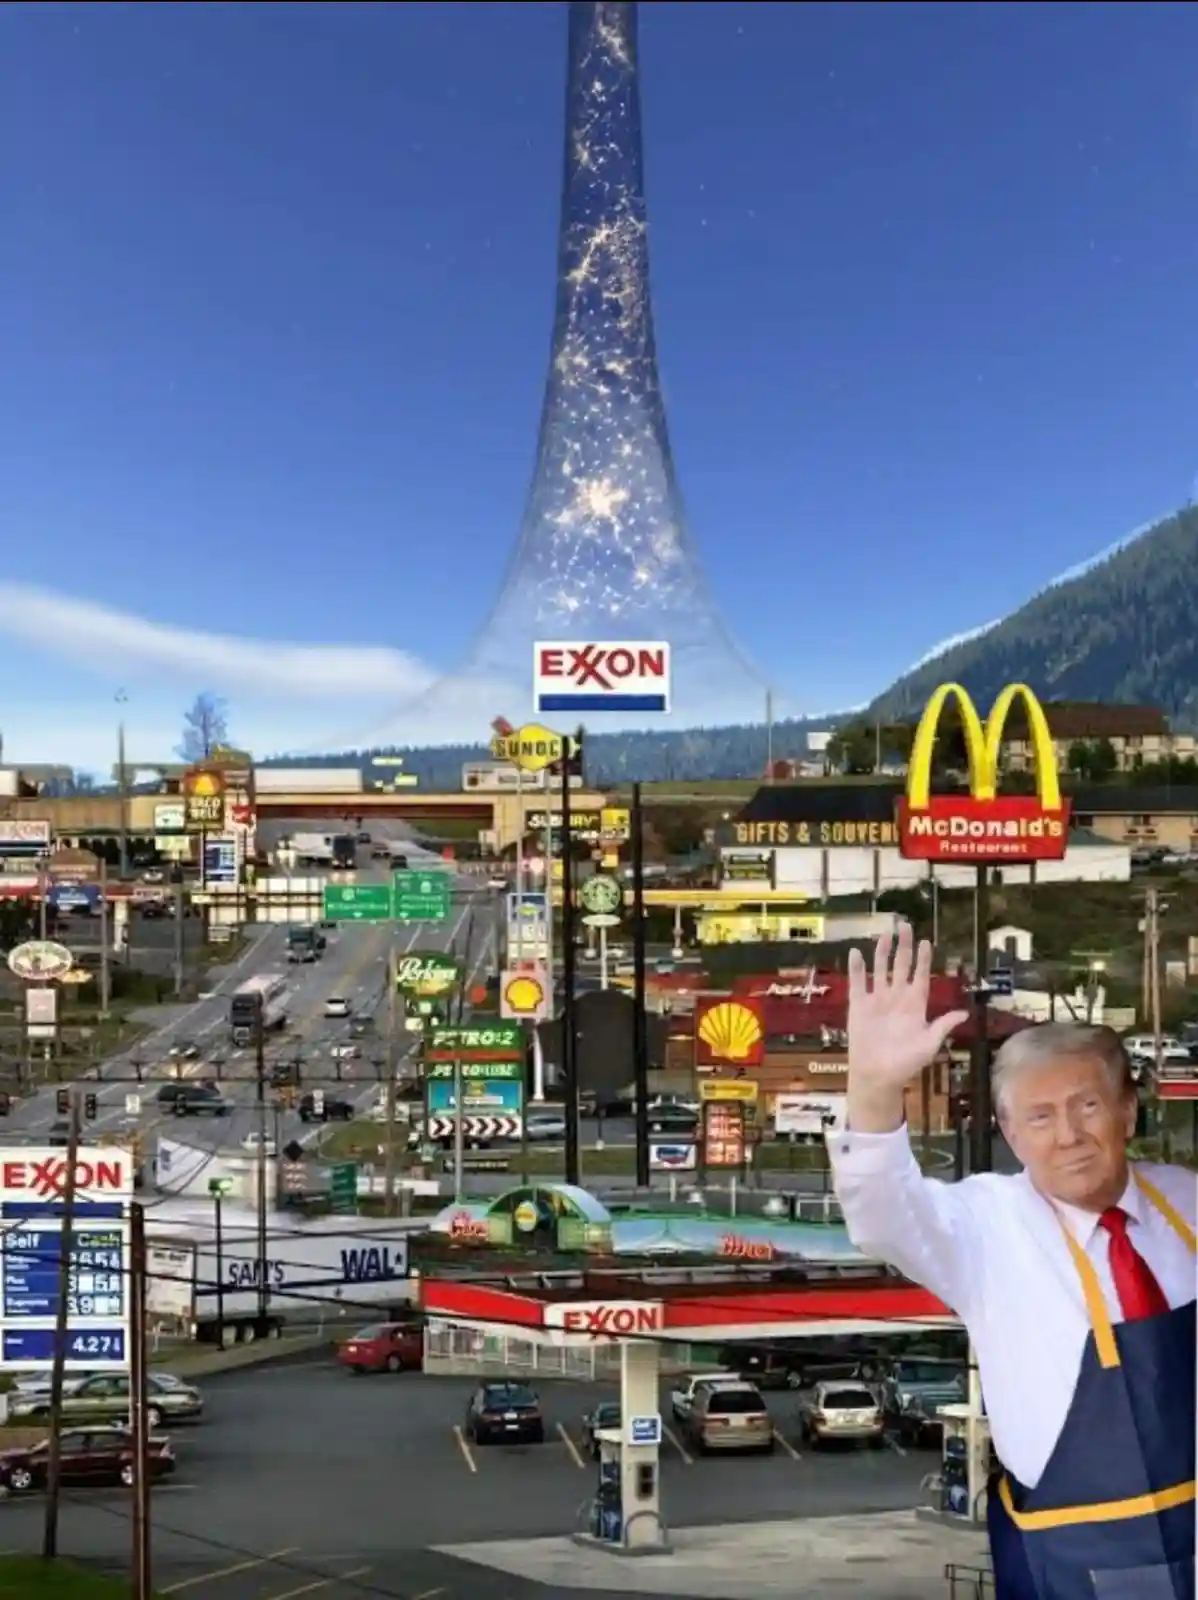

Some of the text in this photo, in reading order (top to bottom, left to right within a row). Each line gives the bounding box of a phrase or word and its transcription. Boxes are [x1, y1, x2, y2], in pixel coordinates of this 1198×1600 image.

[540, 644, 664, 690] EXXON
[496, 738, 566, 758] SUNOC
[736, 821, 790, 844] GIFTS
[799, 821, 811, 842] &
[908, 815, 1064, 838] McDonald's
[940, 841, 1028, 853] Restaurant
[3, 1156, 122, 1196] EXXON
[5, 1232, 40, 1249] Self
[563, 1304, 659, 1341] EXXON
